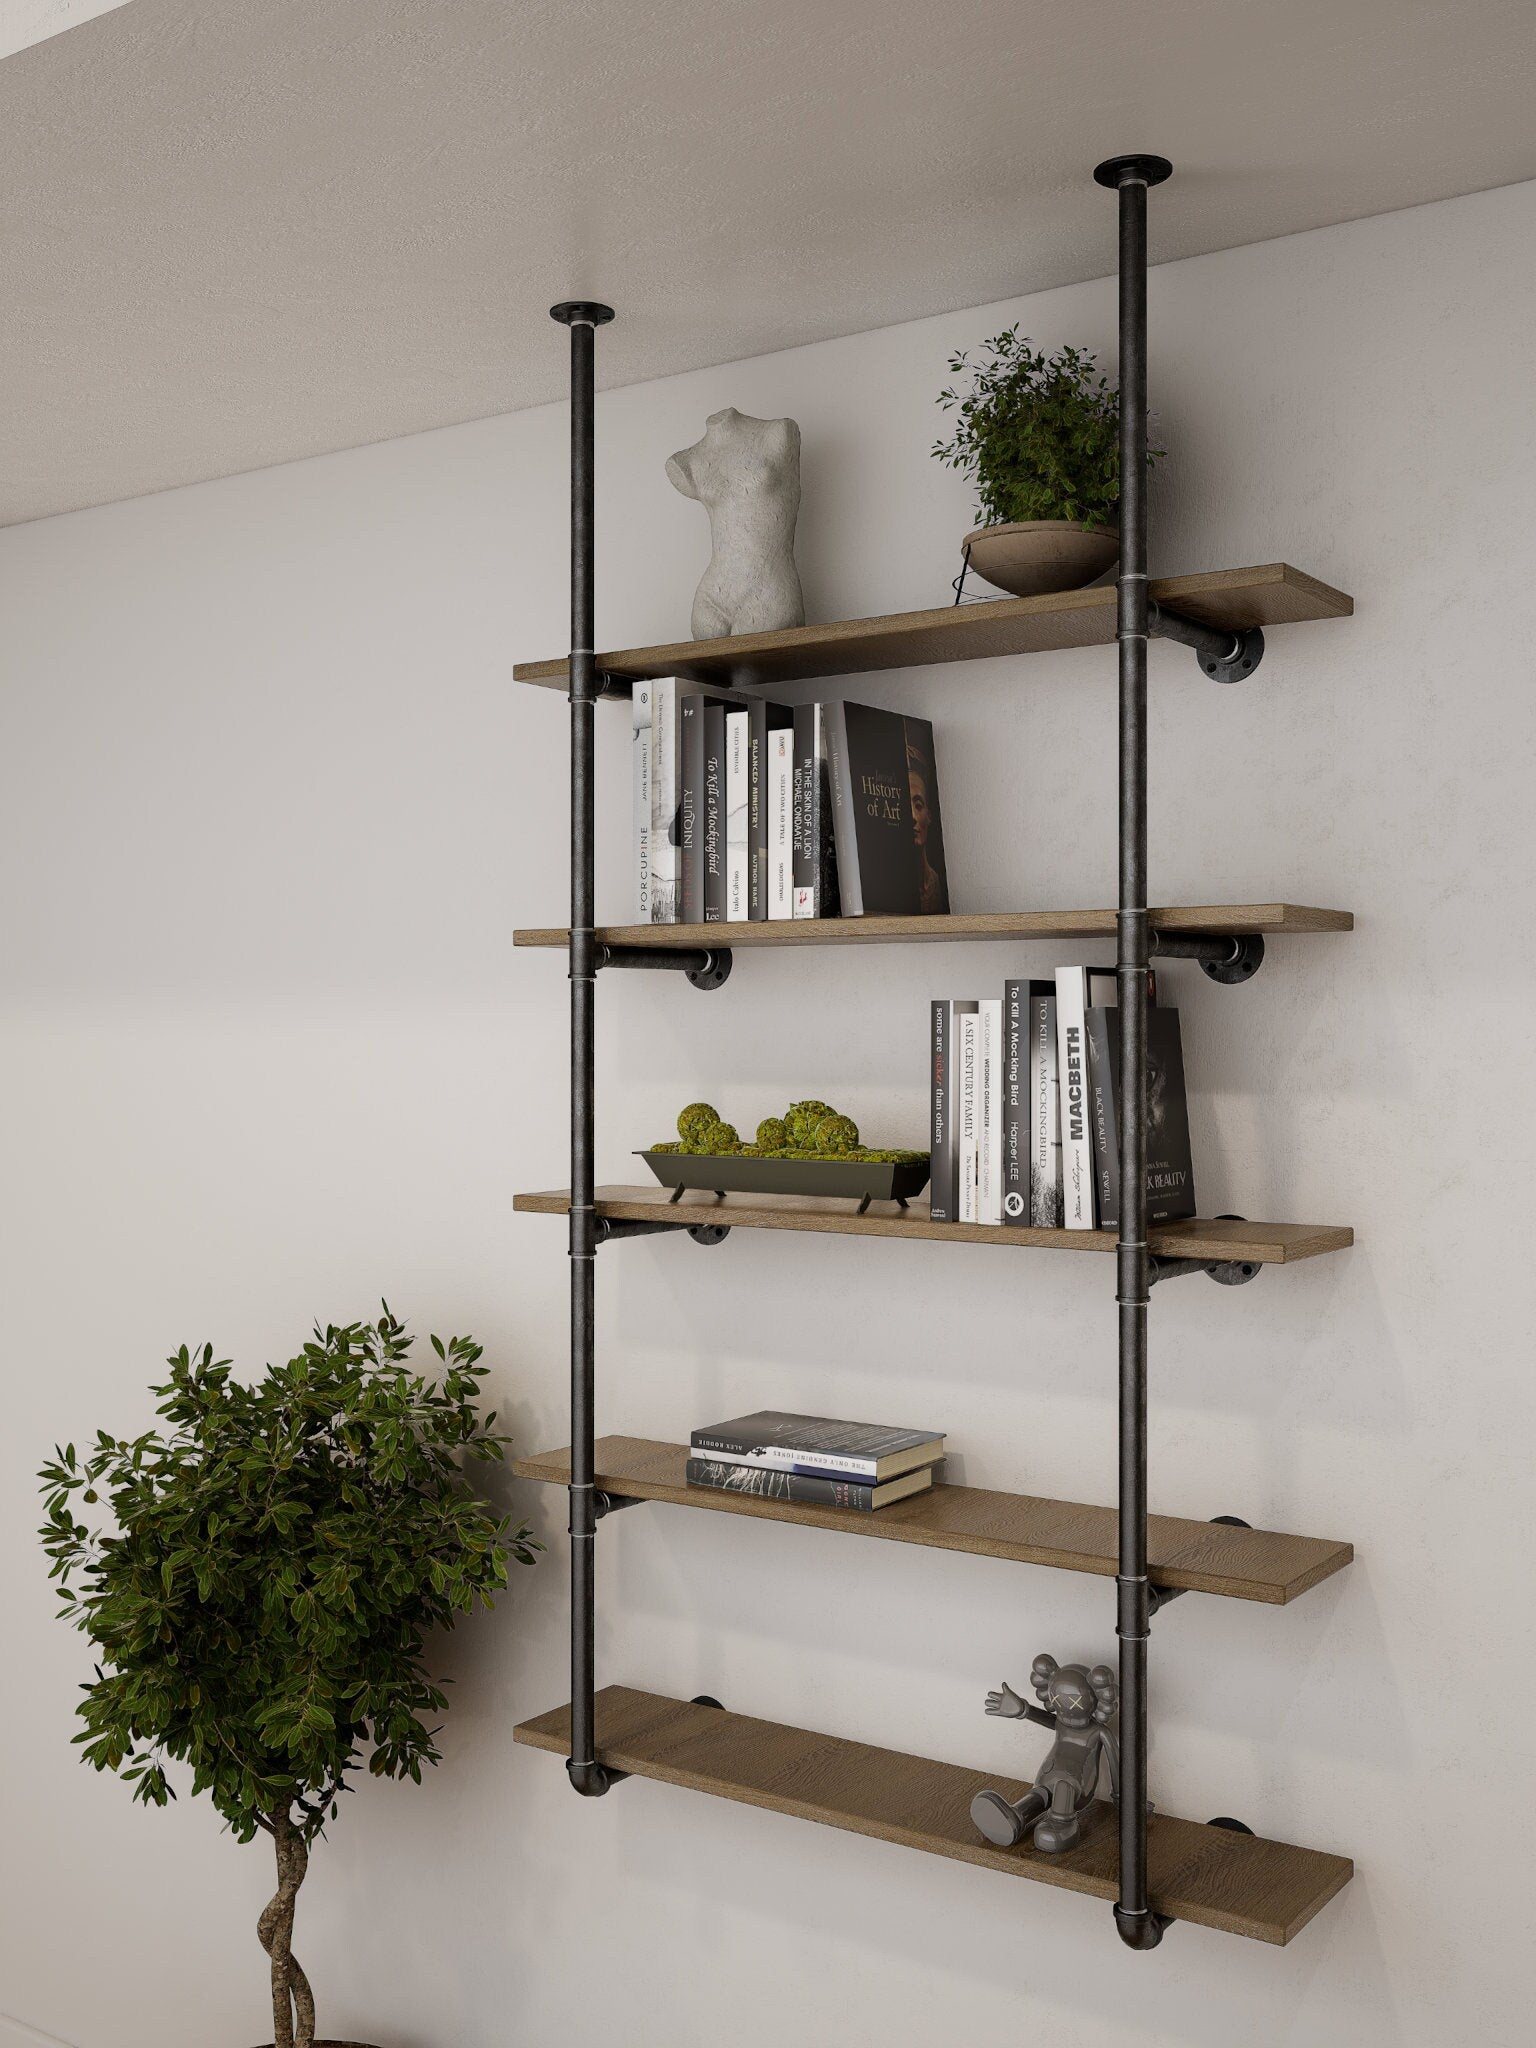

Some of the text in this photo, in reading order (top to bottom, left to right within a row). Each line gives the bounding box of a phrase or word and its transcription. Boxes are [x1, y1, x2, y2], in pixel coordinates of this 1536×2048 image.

[708, 756, 718, 771] To
[708, 773, 719, 795] Kill
[862, 775, 902, 799] History
[684, 789, 696, 849] INIQUITY
[779, 814, 786, 823] OF
[793, 768, 803, 851] MICHAEL ONDAATJE
[803, 758, 812, 859] IN THE SKIN OF A LION
[867, 798, 902, 820] of Art
[705, 806, 719, 876] Mockingbird
[640, 826, 648, 912] PORCUPINE
[936, 1007, 944, 1034] some
[936, 1036, 944, 1053] are
[1009, 985, 1020, 1106] To Kill A Mocking Bird
[964, 1019, 974, 1140] A SIX CENTURY FAMILY
[983, 1058, 991, 1089] WEDDING
[1039, 1000, 1048, 1169] TO KILL A MOCKINGBIRD
[1066, 1027, 1083, 1141] MACBETH
[936, 1087, 944, 1110] than
[983, 1090, 991, 1128] ORGANIZER
[936, 1112, 944, 1144] others
[1095, 1087, 1108, 1154] BLACK BEAUTY
[1008, 1121, 1019, 1181] Harper LEE
[1102, 1170, 1111, 1204] SEWELL
[1154, 1170, 1187, 1189] BEAUTY
[725, 1443, 743, 1451] ALEX
[851, 1462, 866, 1470] THE
